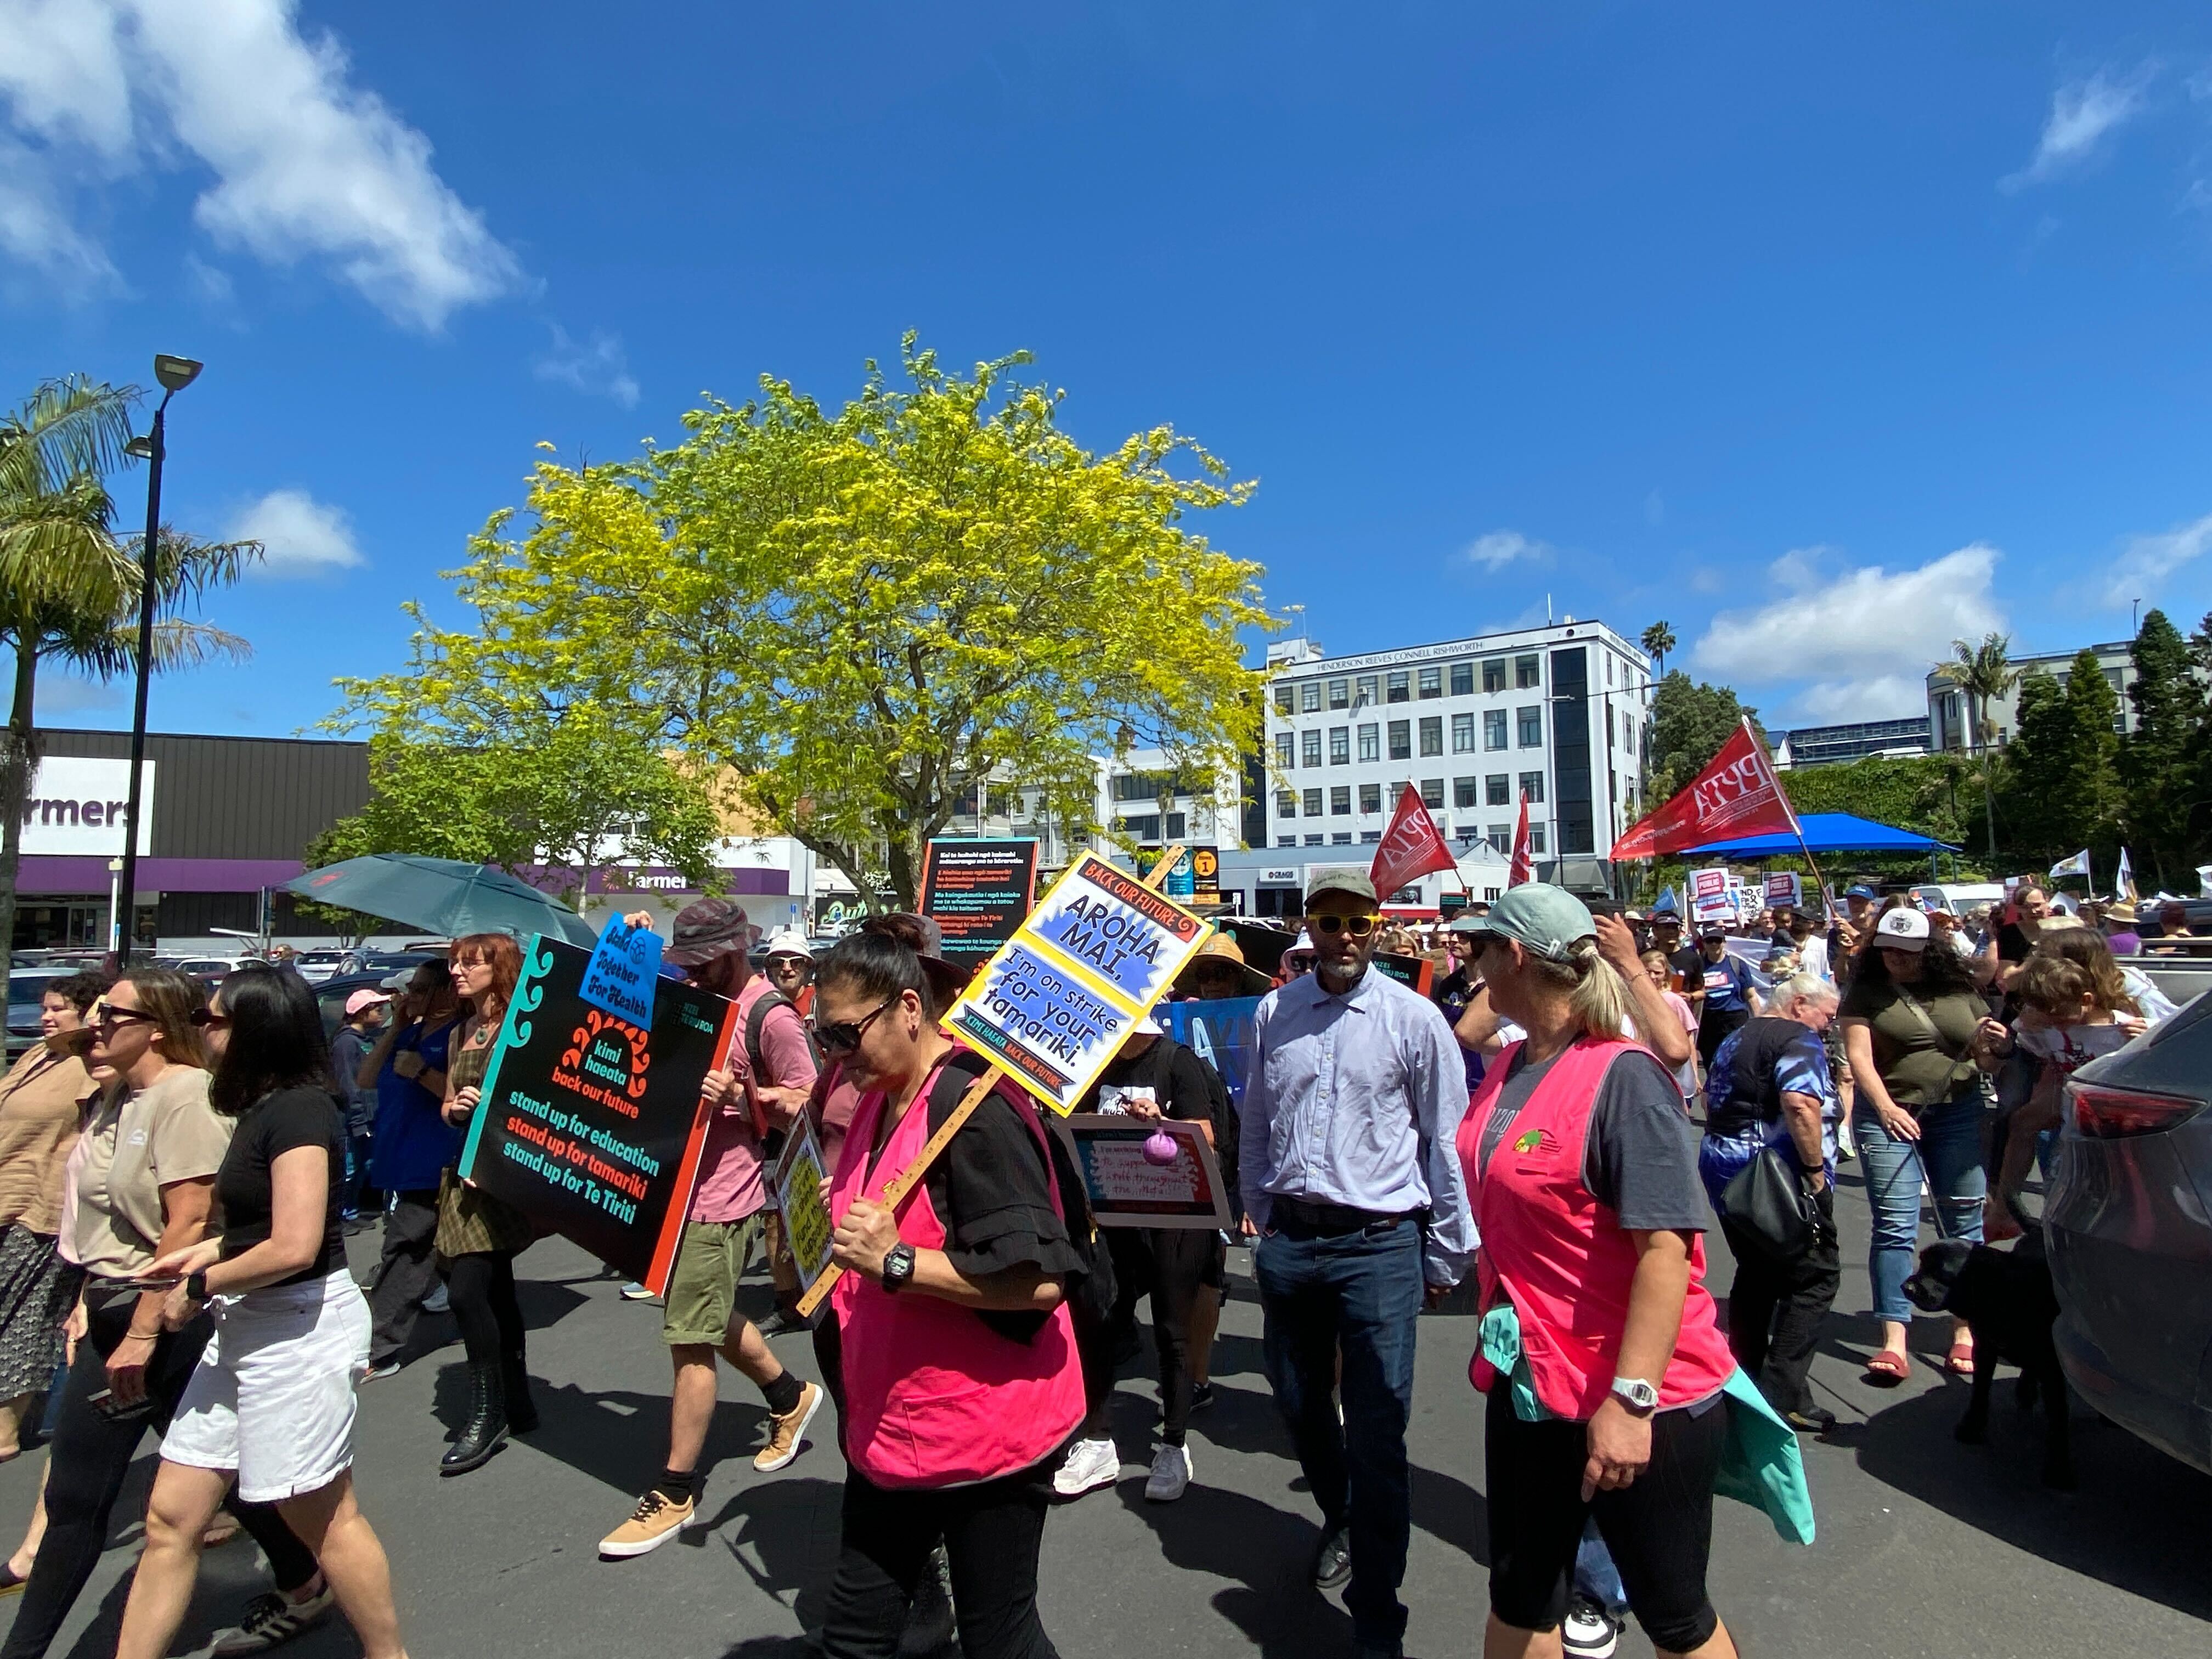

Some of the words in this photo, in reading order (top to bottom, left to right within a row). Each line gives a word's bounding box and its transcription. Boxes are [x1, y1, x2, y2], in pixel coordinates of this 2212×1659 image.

[1317, 658, 1363, 672] HENDERSON
[1365, 655, 1392, 665] REEVES
[1395, 651, 1431, 662] CONNELL
[1433, 642, 1483, 655] RISHWORTH
[1202, 861, 1209, 872] 1
[1085, 863, 1115, 889] BACK
[1114, 881, 1139, 905] OUR
[1135, 892, 1179, 927] FUTURE
[606, 926, 631, 952] Stand
[1059, 922, 1128, 981] MAI,
[1065, 895, 1160, 964] AROHA
[588, 974, 607, 998] For
[607, 984, 647, 1018] Health
[596, 950, 639, 986] Together
[1005, 948, 1037, 978] I'm
[1041, 975, 1062, 995] on
[1064, 991, 1118, 1031] strike
[1394, 970, 1409, 979] ROA
[698, 1019, 713, 1035] ROA
[983, 988, 1081, 1067] tamariki.
[1000, 971, 1040, 1002] for
[1041, 1002, 1096, 1041] your
[584, 1054, 627, 1086] haeata
[594, 1039, 622, 1064] kimi
[965, 1014, 985, 1032] KIMI
[981, 1028, 1008, 1049] HAEATA
[1005, 1043, 1025, 1061] BACK
[1022, 1056, 1039, 1072] OUR
[1035, 1066, 1063, 1088] FUTURE
[552, 1066, 582, 1092] back
[582, 1084, 603, 1101] our
[602, 1090, 639, 1119] future
[507, 1116, 548, 1146] stand
[546, 1136, 566, 1158] up
[566, 1141, 588, 1166] for
[588, 1154, 648, 1200] tamariki
[509, 1091, 550, 1119] stand
[549, 1109, 568, 1130] up
[568, 1114, 590, 1138] for
[590, 1130, 659, 1177] education
[503, 1142, 544, 1172] stand
[543, 1162, 562, 1184] up
[562, 1167, 583, 1193] for
[584, 1180, 600, 1204] Te
[603, 1189, 637, 1224] Tiriti
